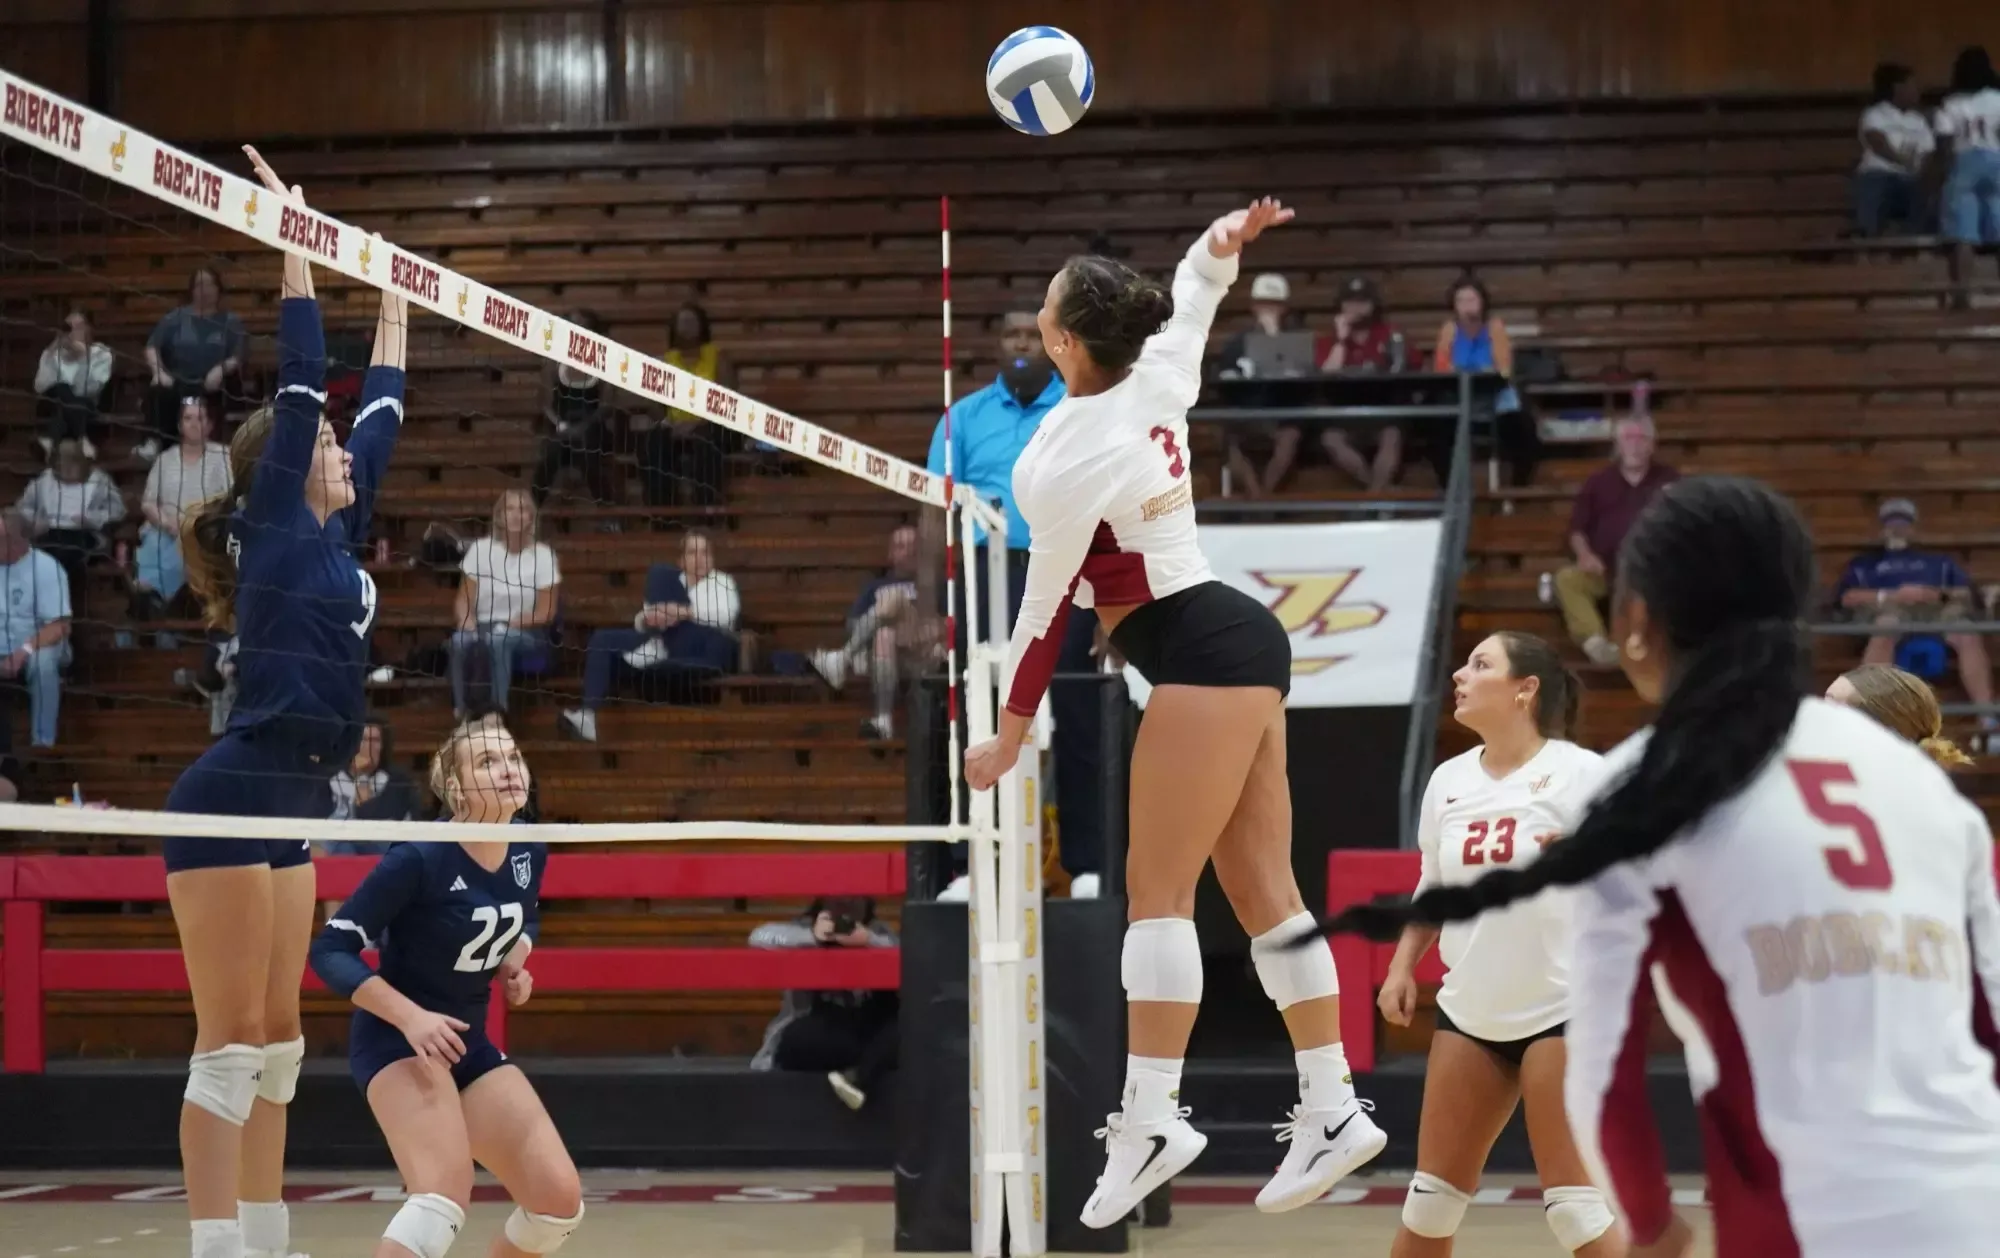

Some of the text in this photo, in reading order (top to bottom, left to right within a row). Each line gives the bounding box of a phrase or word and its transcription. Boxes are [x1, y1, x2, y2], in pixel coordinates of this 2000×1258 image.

[4, 81, 85, 153] BOBCATS
[153, 147, 223, 212] BOBCATS
[278, 204, 340, 261] BOBCATS
[391, 253, 441, 304] BOBCATS
[483, 295, 530, 341] BOBCATS
[567, 330, 608, 373] BOBCATS
[1150, 425, 1186, 479] 3
[1463, 816, 1517, 866] 23
[1784, 760, 1895, 892] 5
[453, 902, 523, 973] 22
